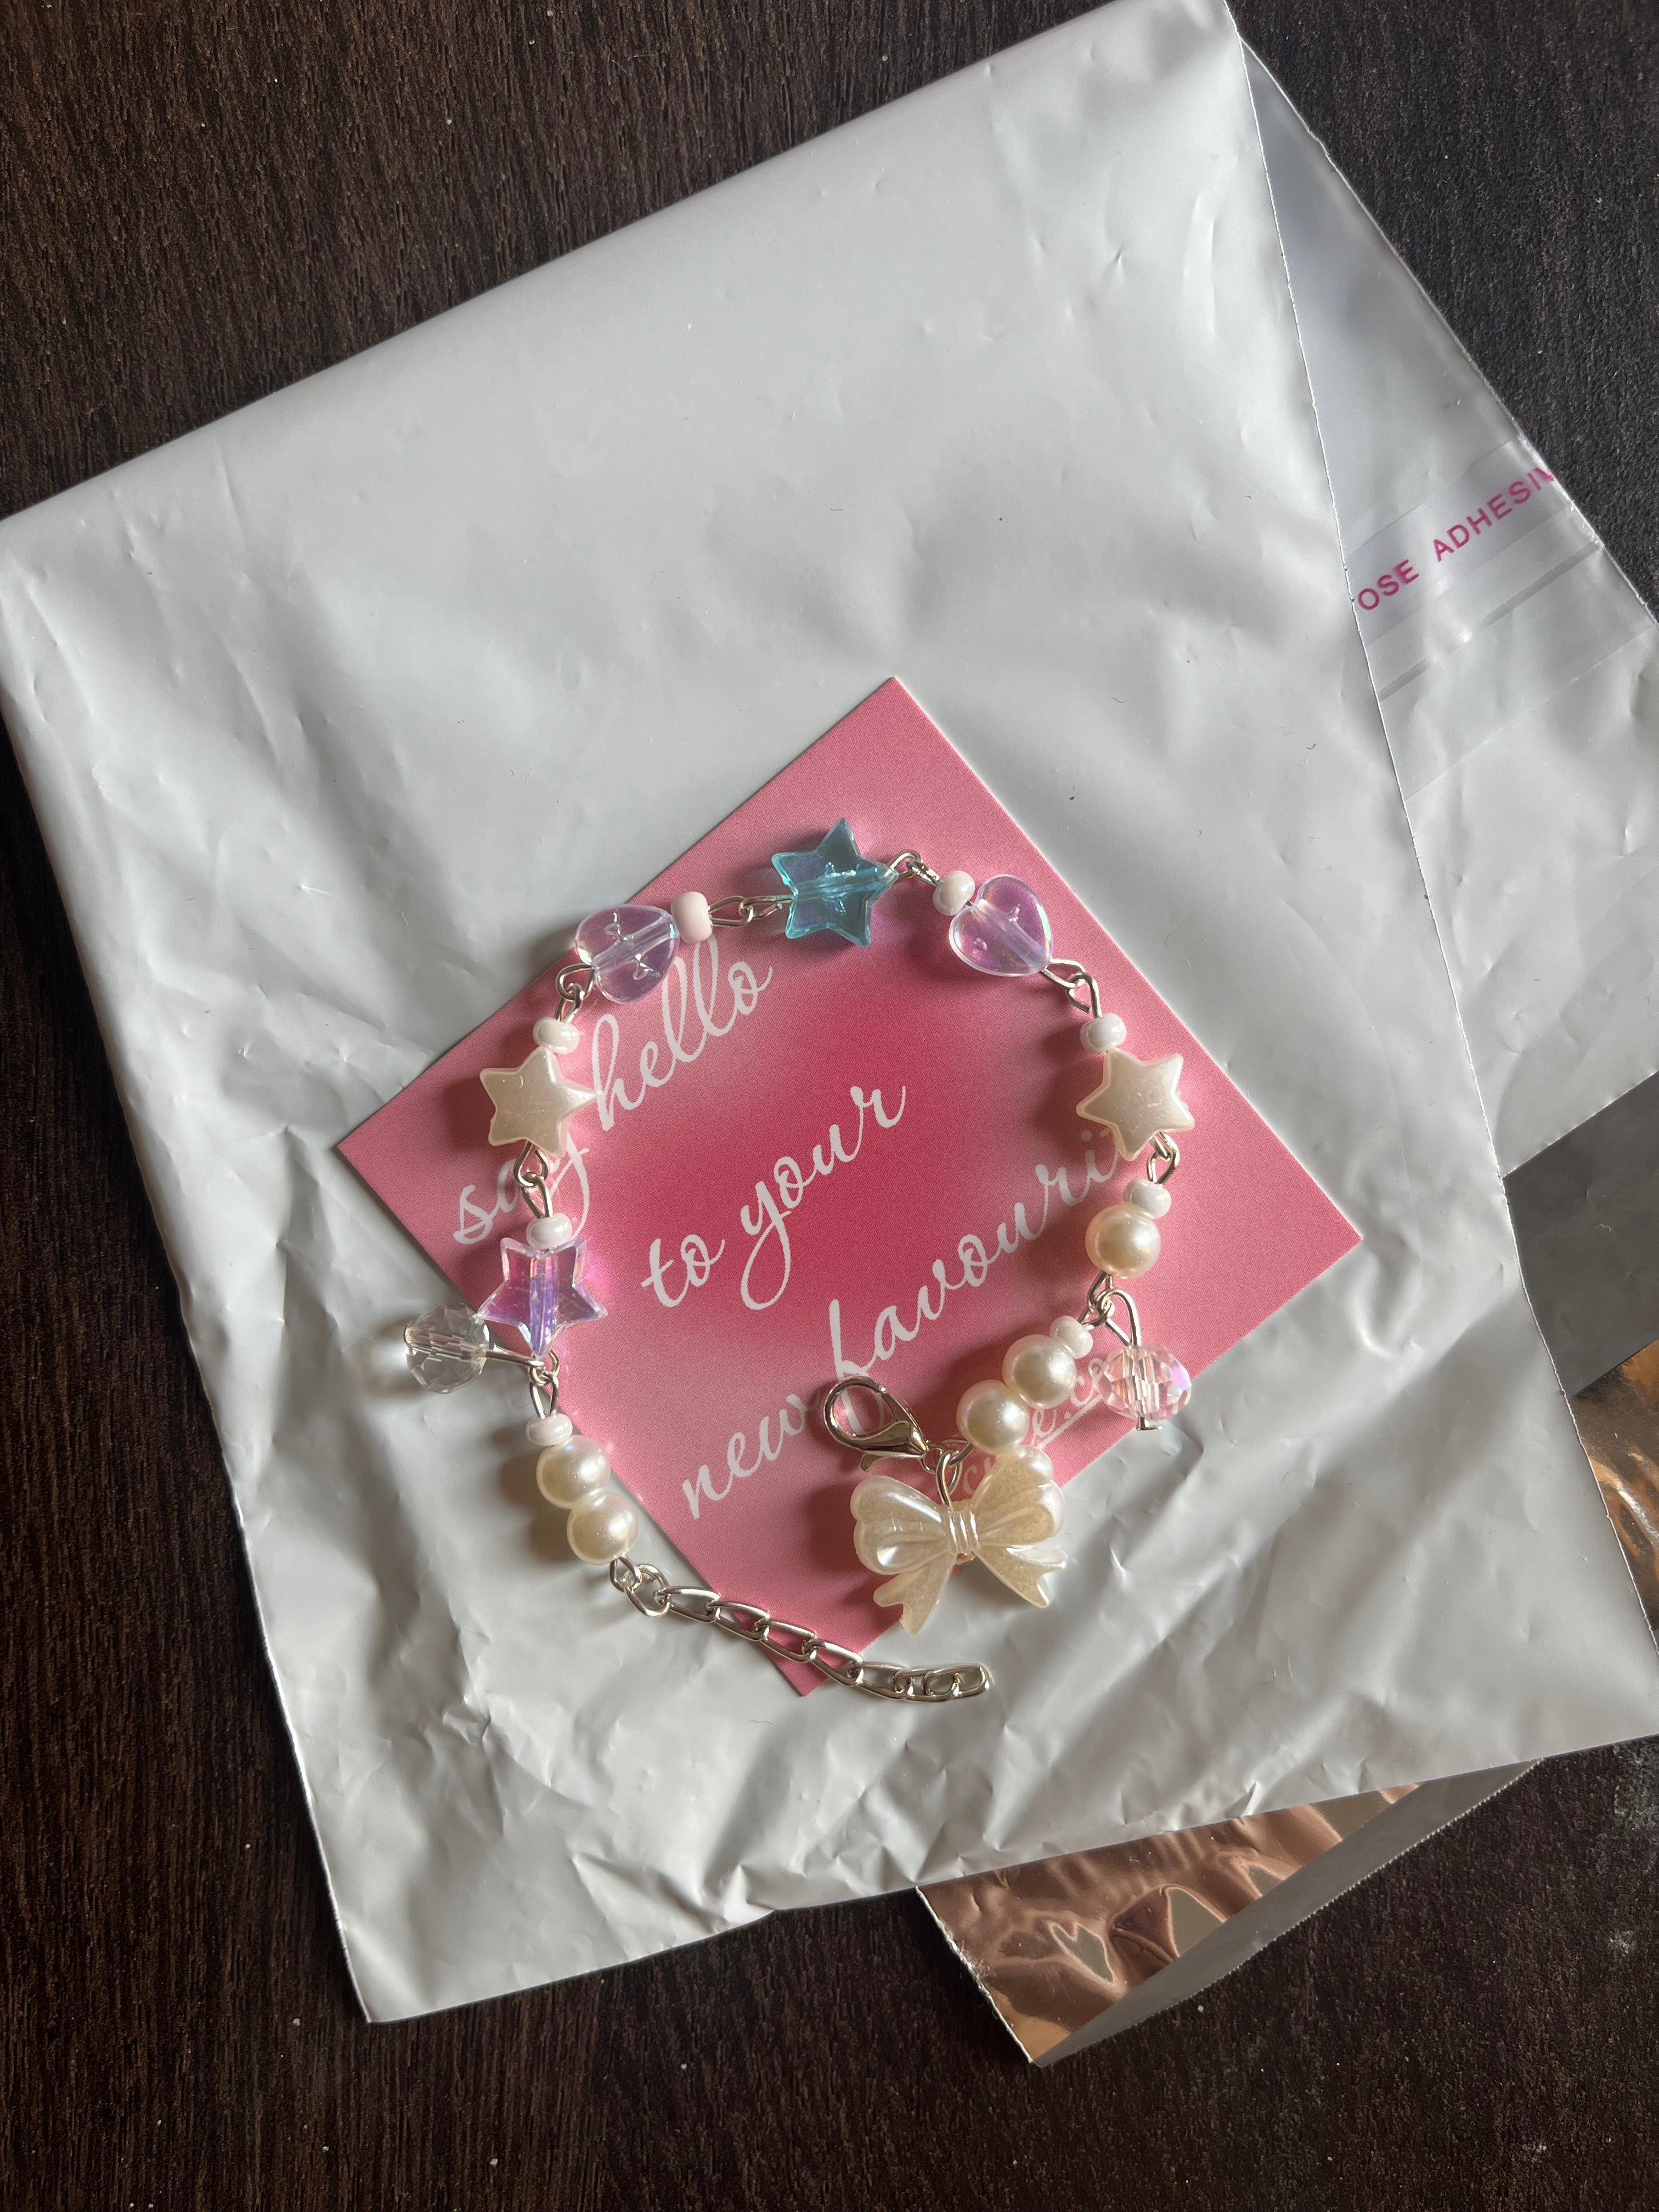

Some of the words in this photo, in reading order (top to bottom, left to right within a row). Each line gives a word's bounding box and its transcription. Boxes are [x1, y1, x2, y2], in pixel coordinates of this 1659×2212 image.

[591, 934, 774, 1131] hello
[641, 1233, 726, 1308] to
[740, 1085, 907, 1311] your
[681, 1389, 820, 1520] new
